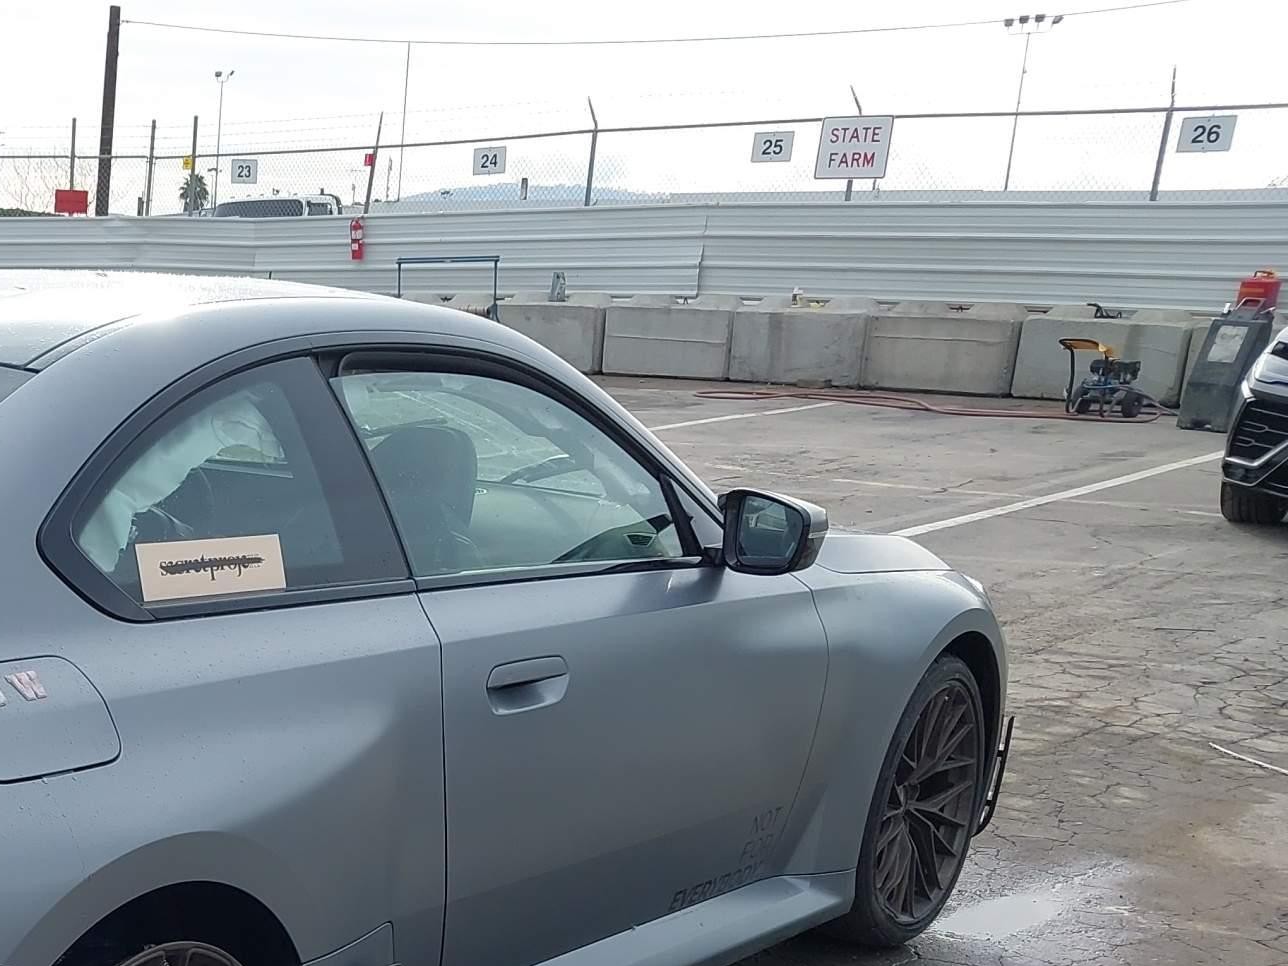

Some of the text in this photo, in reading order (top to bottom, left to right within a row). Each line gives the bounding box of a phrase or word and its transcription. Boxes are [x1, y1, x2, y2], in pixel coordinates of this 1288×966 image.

[829, 126, 883, 144] STATE
[1191, 124, 1222, 144] 26
[761, 139, 784, 156] 25
[480, 153, 498, 169] 24
[827, 151, 876, 168] FARM
[237, 164, 251, 178] 23
